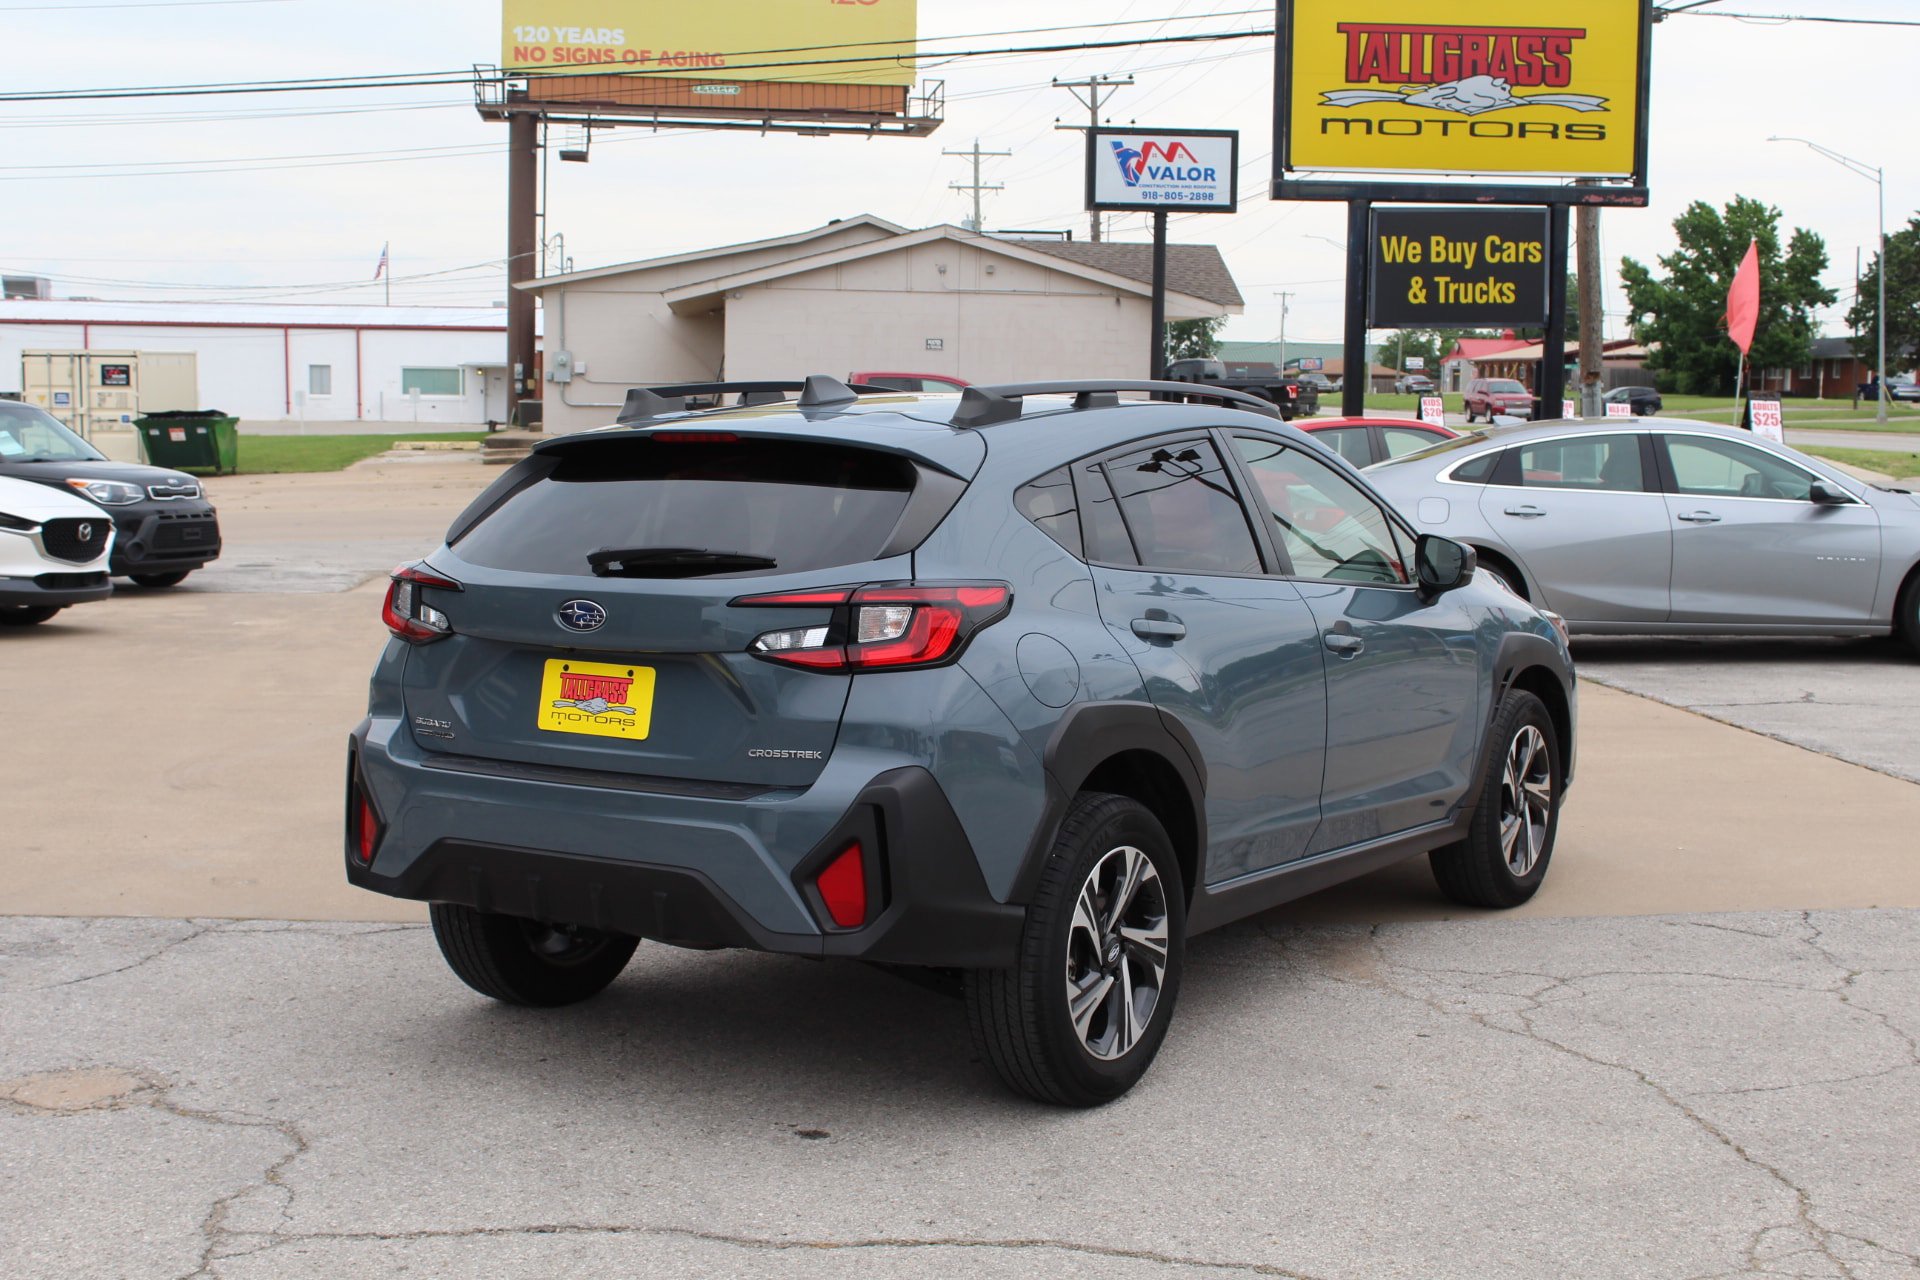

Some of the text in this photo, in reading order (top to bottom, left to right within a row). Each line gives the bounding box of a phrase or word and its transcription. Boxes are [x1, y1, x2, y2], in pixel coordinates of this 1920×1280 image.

[513, 26, 625, 46] 120 YEARS
[514, 46, 726, 67] NO SIGNS OF AGING
[1337, 22, 1586, 88] TALLGRASS
[1321, 118, 1606, 140] MOTORS
[1147, 166, 1216, 181] VALOR
[1142, 191, 1214, 201] 918-805-2898
[1381, 235, 1542, 270] We Buy Cars
[1408, 276, 1516, 304] & Trucks
[1424, 408, 1441, 417] $20
[1754, 412, 1779, 427] $25
[560, 672, 634, 704] TALLGRASS
[551, 712, 636, 727] MOTORS
[748, 749, 822, 759] CROSSTREK
